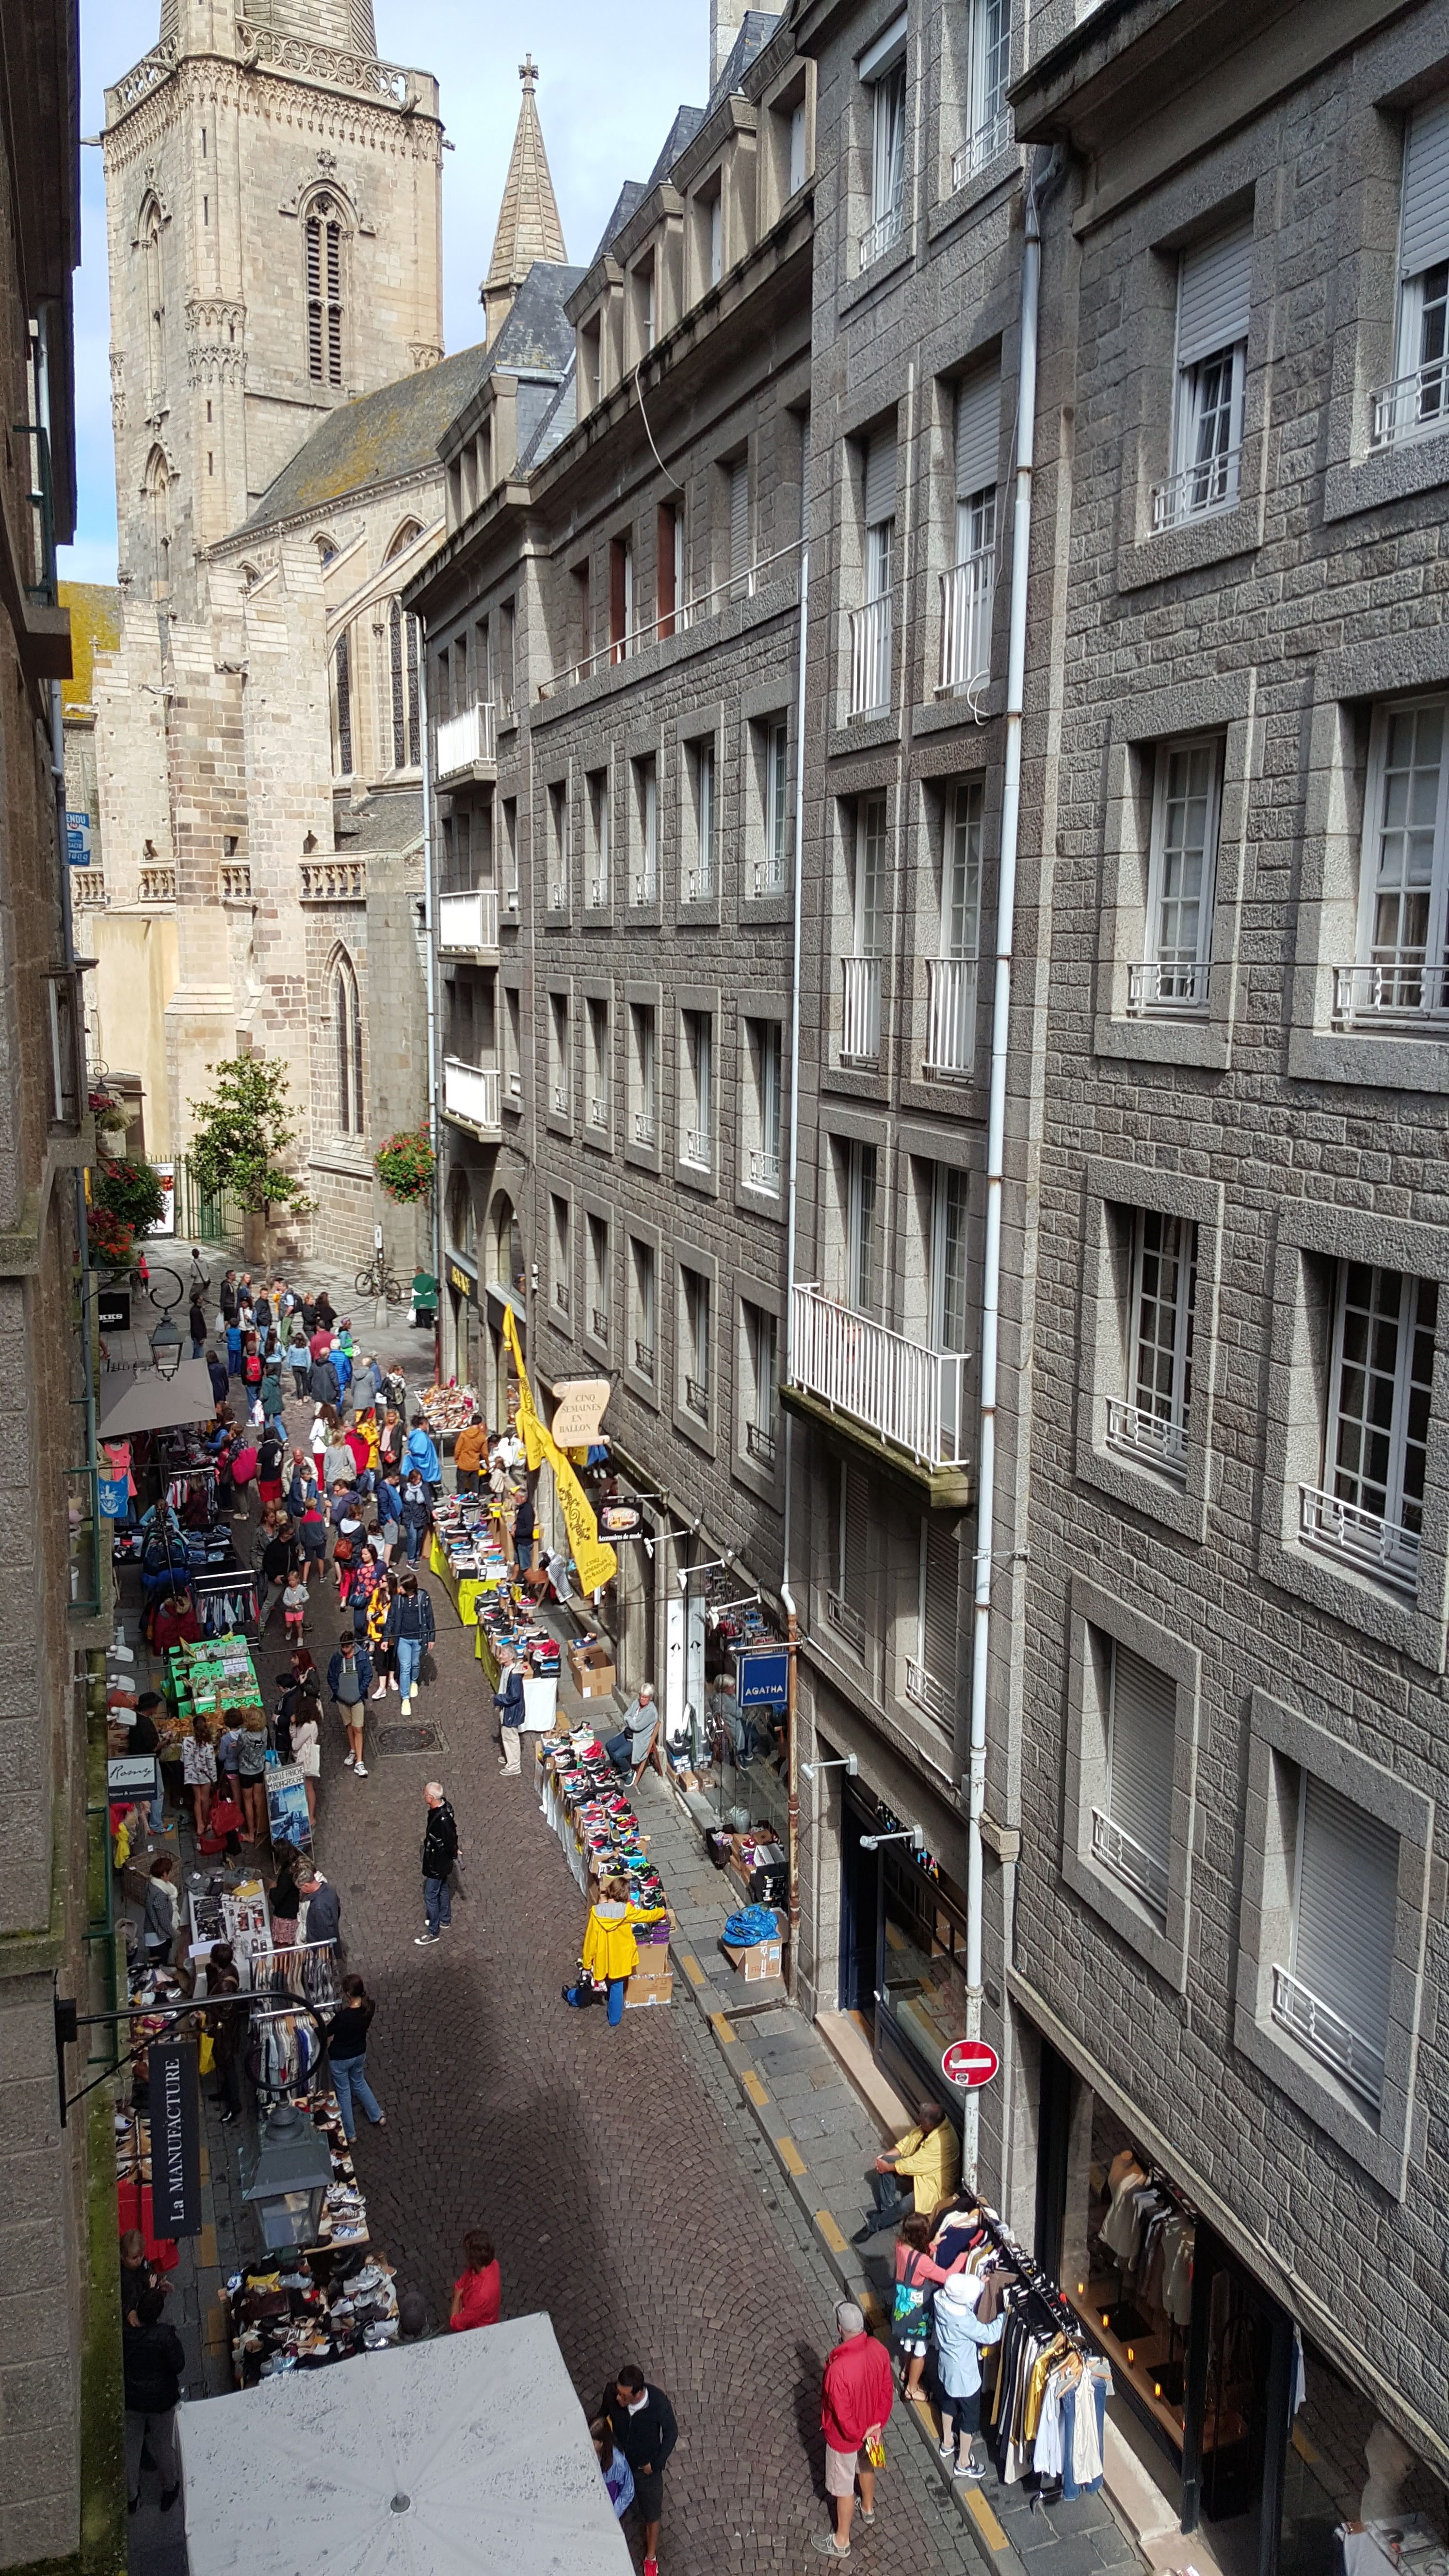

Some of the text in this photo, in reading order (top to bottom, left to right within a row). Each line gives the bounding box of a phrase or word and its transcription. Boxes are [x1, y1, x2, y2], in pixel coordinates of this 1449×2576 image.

[66, 814, 85, 824] ENDU
[576, 1394, 596, 1402] CINQ
[562, 1403, 601, 1413] SEMAINES
[560, 1424, 591, 1433] BALLON
[745, 1685, 783, 1696] AGATHA
[109, 1765, 153, 1780] Romy
[266, 1771, 285, 1783] VANILLE
[267, 1775, 305, 1790] MADAGASCAR
[165, 2058, 185, 2221] La MANUFACTURE
